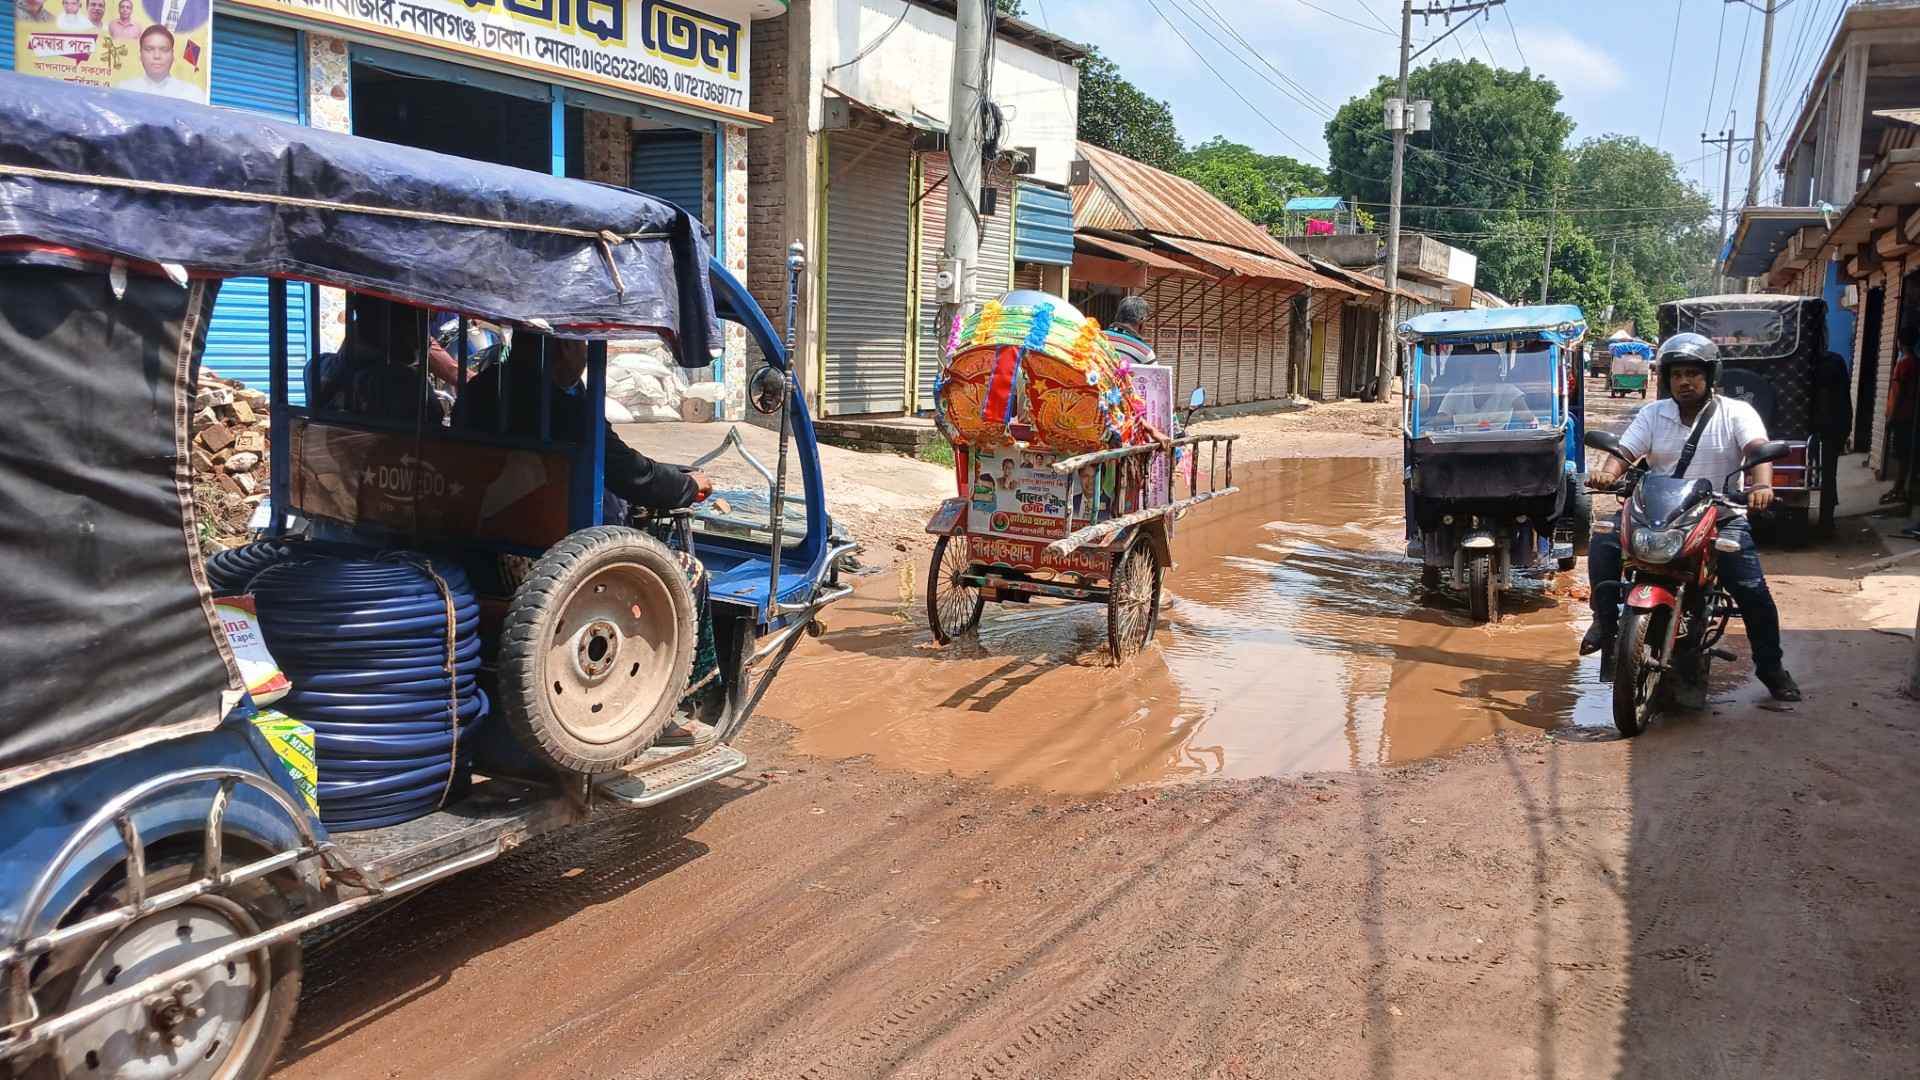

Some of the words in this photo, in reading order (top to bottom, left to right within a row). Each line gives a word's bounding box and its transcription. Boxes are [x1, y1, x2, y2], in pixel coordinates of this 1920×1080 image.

[642, 0, 742, 74] তেল
[68, 39, 94, 52] পদে
[674, 72, 743, 107] 01727369777
[223, 619, 250, 632] ina
[228, 632, 256, 643] Tape
